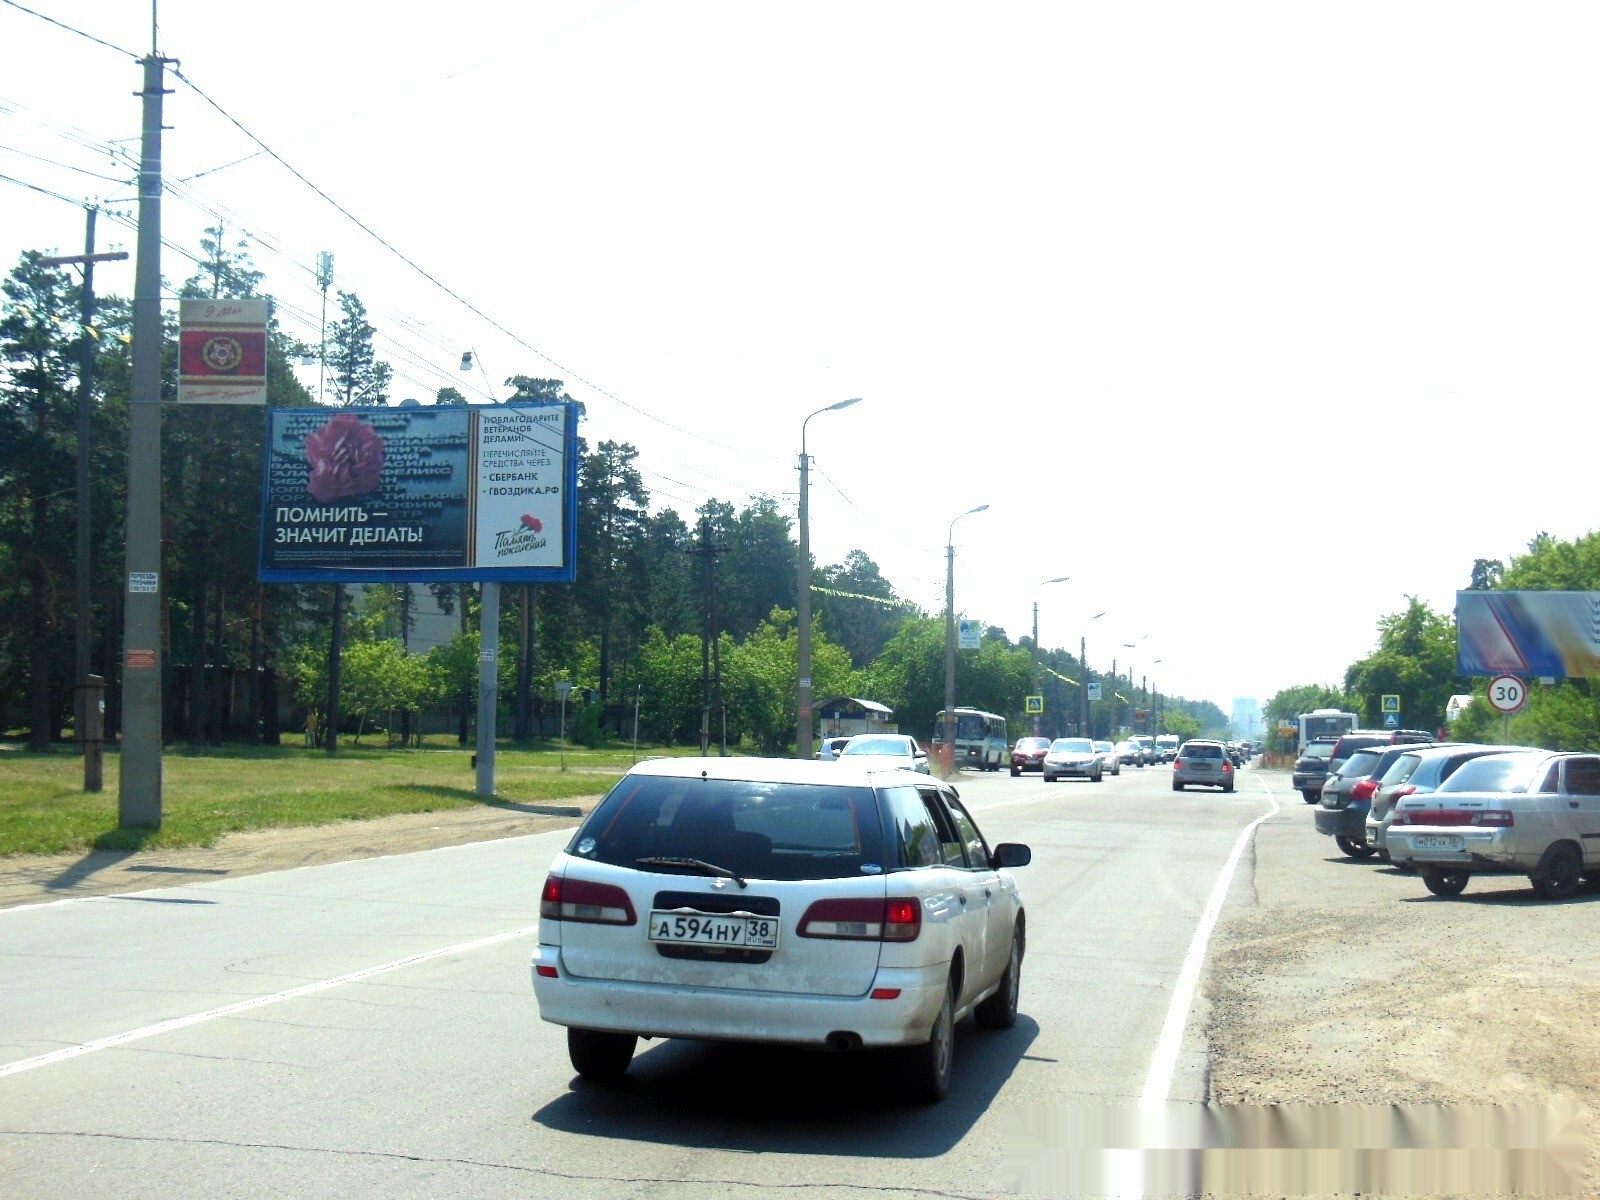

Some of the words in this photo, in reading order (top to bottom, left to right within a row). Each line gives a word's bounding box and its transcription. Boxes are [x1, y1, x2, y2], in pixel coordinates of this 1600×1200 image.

[203, 305, 215, 318] 9
[484, 414, 560, 424] ПОБЛАГОДАРИТЕ
[484, 425, 532, 434] ВЕТЕРАНОВ
[483, 435, 524, 444] ДЕЛАМИ!
[483, 448, 547, 458] ПЕРЕЧИСЛЯЙТЕ
[482, 459, 524, 468] СРЕДСТВА
[489, 473, 538, 481] СБЕРБАНК
[489, 486, 559, 496] ГВОЗДИКА.РФ
[276, 507, 369, 523] ПОМНИТЬ
[275, 527, 347, 544] ЗНАЧИТ
[350, 527, 423, 545] ДЕЛАТЬ!
[495, 530, 537, 549] Память
[497, 538, 547, 557] поколений
[1496, 687, 1517, 701] 30
[749, 921, 769, 937] 38
